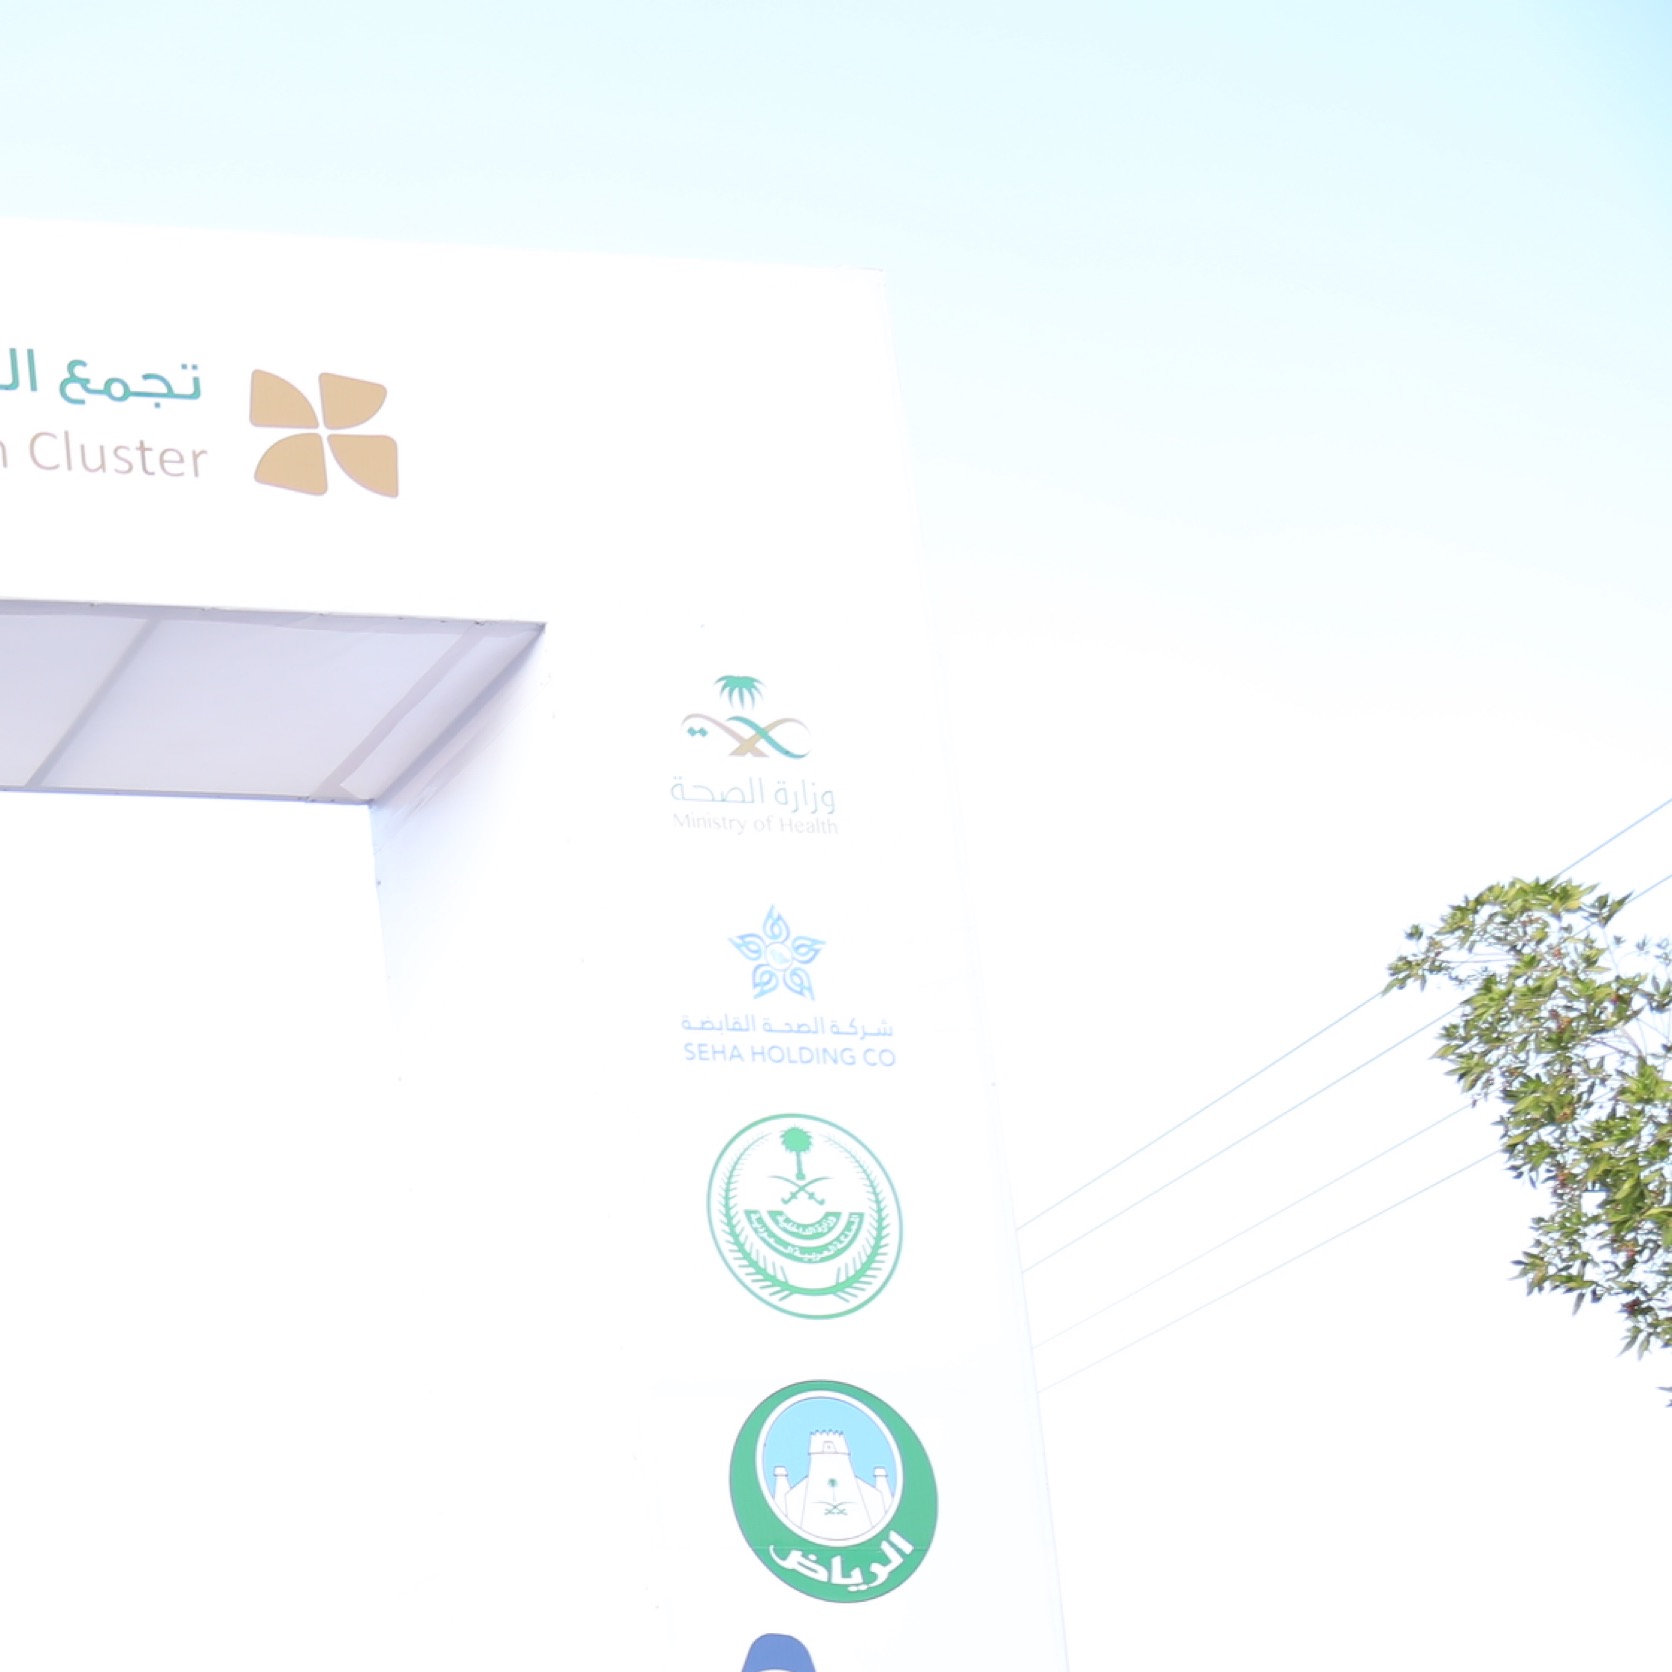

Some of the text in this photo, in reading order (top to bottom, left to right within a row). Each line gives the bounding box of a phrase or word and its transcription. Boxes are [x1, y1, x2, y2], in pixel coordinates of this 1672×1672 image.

[58, 359, 202, 409] تجمع
[29, 430, 208, 478] Cluster
[669, 775, 837, 815] وزارة الصحة
[672, 812, 839, 836] Ministry of Health
[680, 1012, 894, 1041] شركة الصحة القابضة
[683, 1041, 897, 1068] SEHA HOLDING CO
[769, 1530, 914, 1591] الرياض
